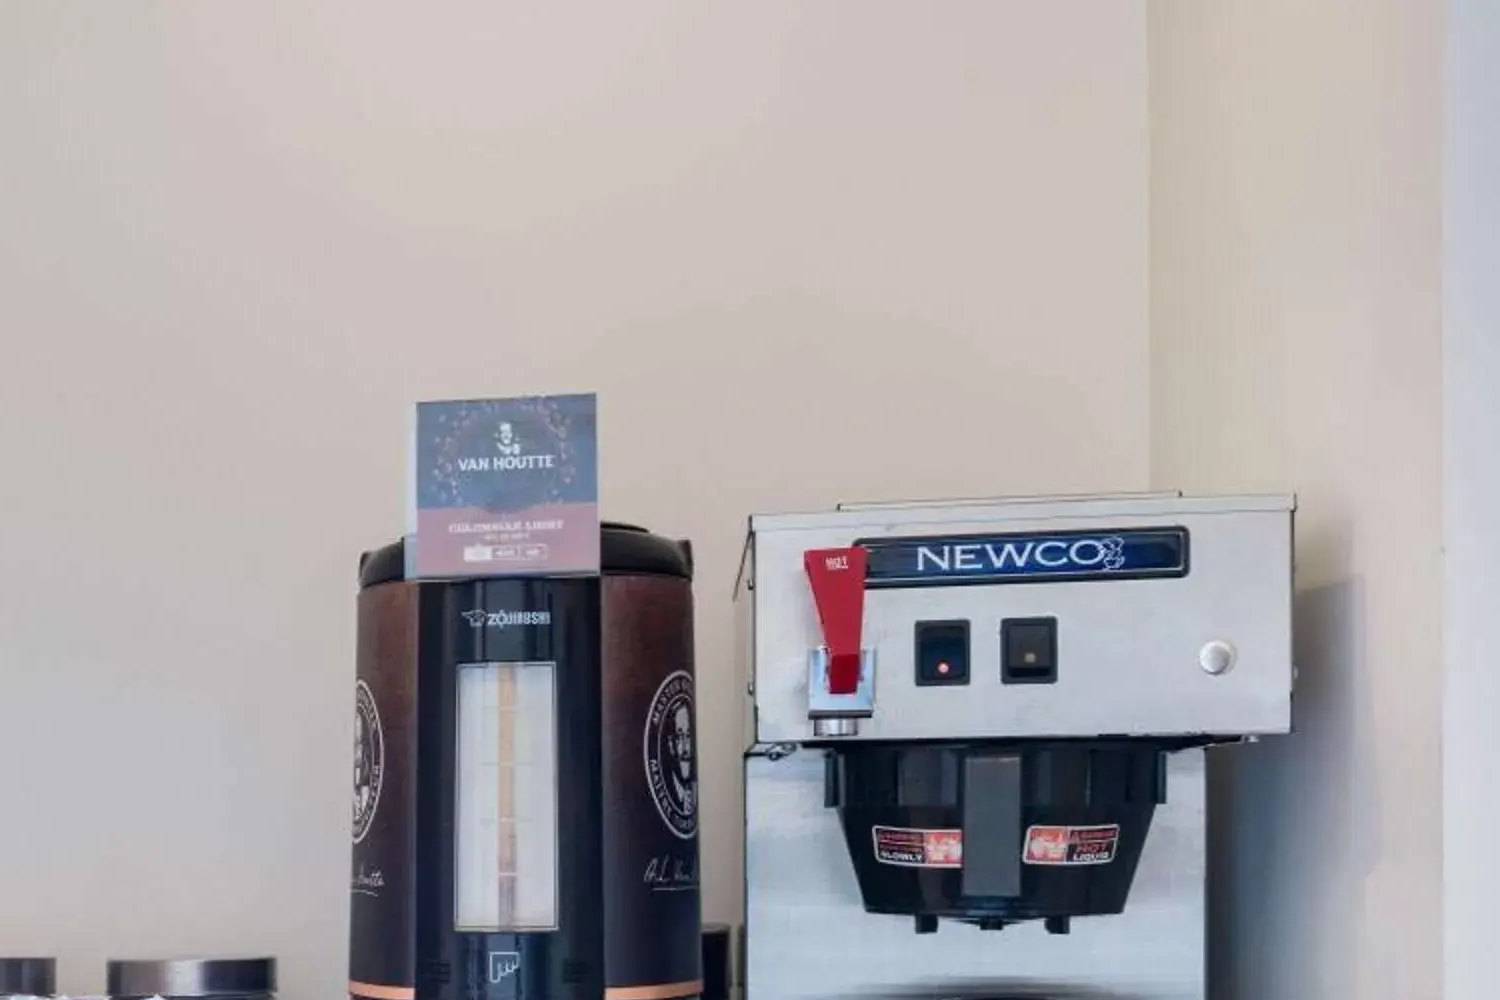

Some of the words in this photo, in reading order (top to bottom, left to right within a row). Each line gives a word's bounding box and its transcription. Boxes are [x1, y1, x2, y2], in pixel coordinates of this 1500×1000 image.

[458, 457, 489, 472] VAN
[493, 454, 556, 471] HOUTTE
[917, 541, 1105, 571] NEWCO
